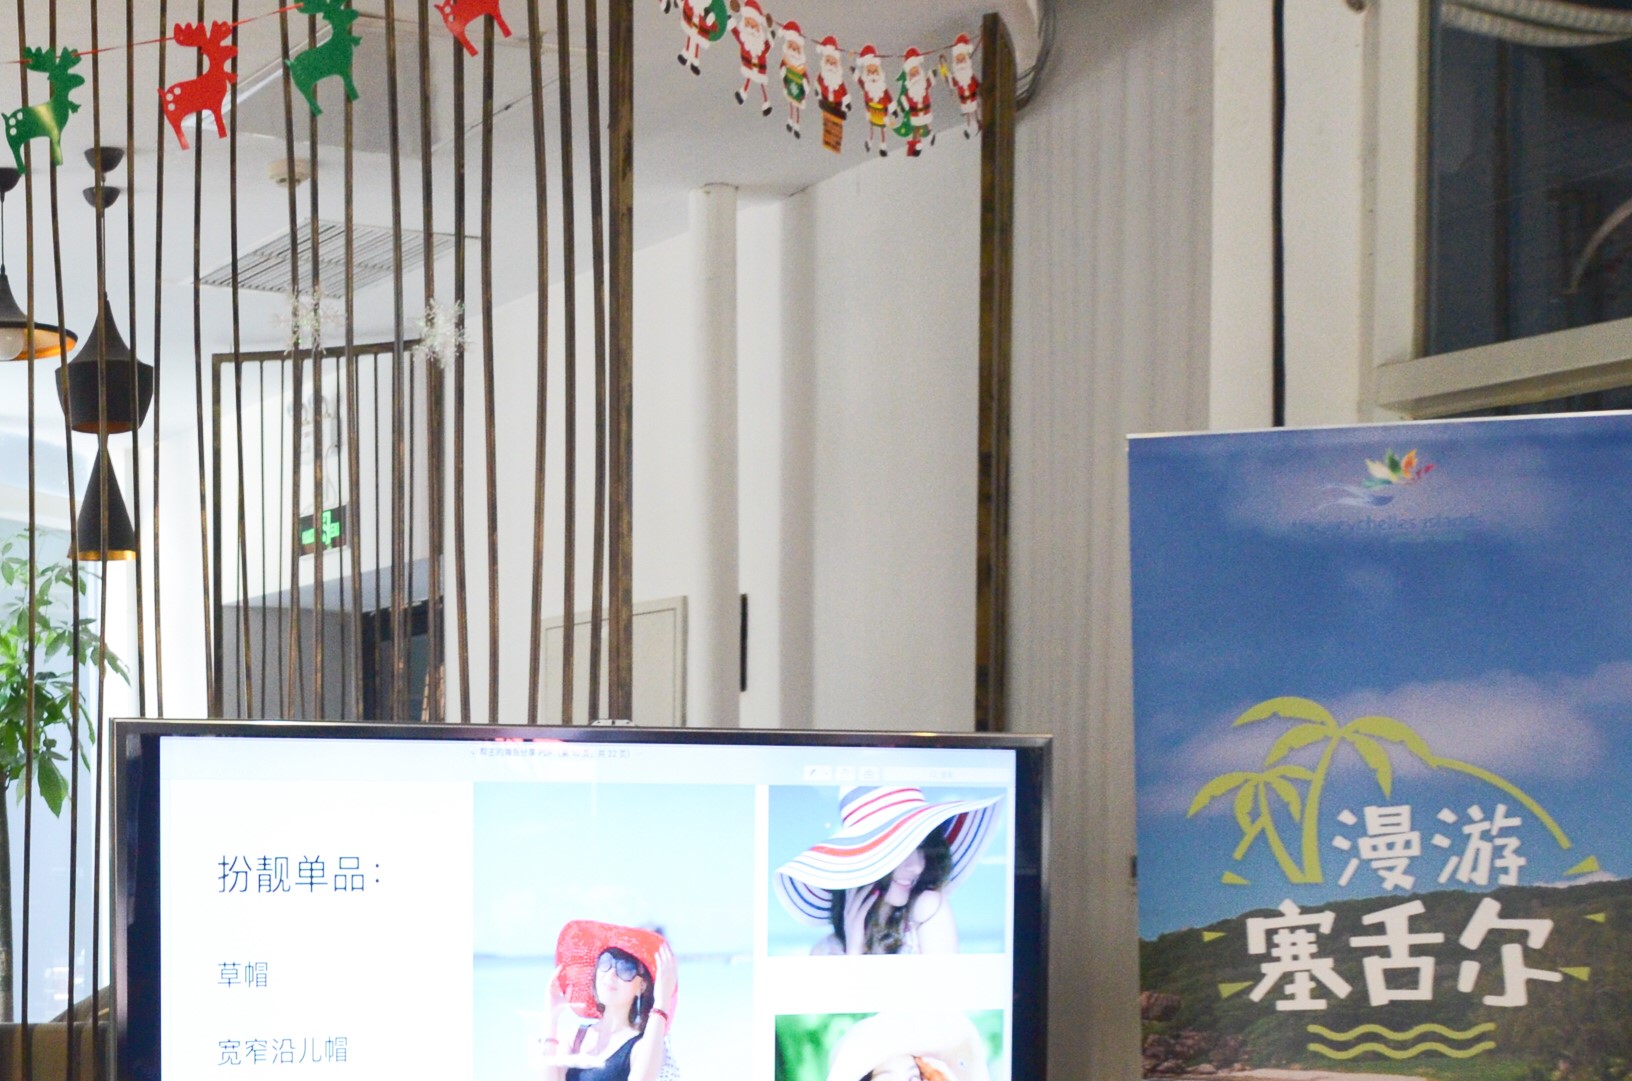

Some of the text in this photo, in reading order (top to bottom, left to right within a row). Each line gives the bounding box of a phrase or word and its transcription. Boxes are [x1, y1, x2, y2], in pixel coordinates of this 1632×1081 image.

[1332, 803, 1527, 890] 漫游
[217, 961, 269, 989] 草帽
[1245, 897, 1563, 1012] 塞舌尔
[217, 1036, 349, 1067] 宽窄沿儿帽
